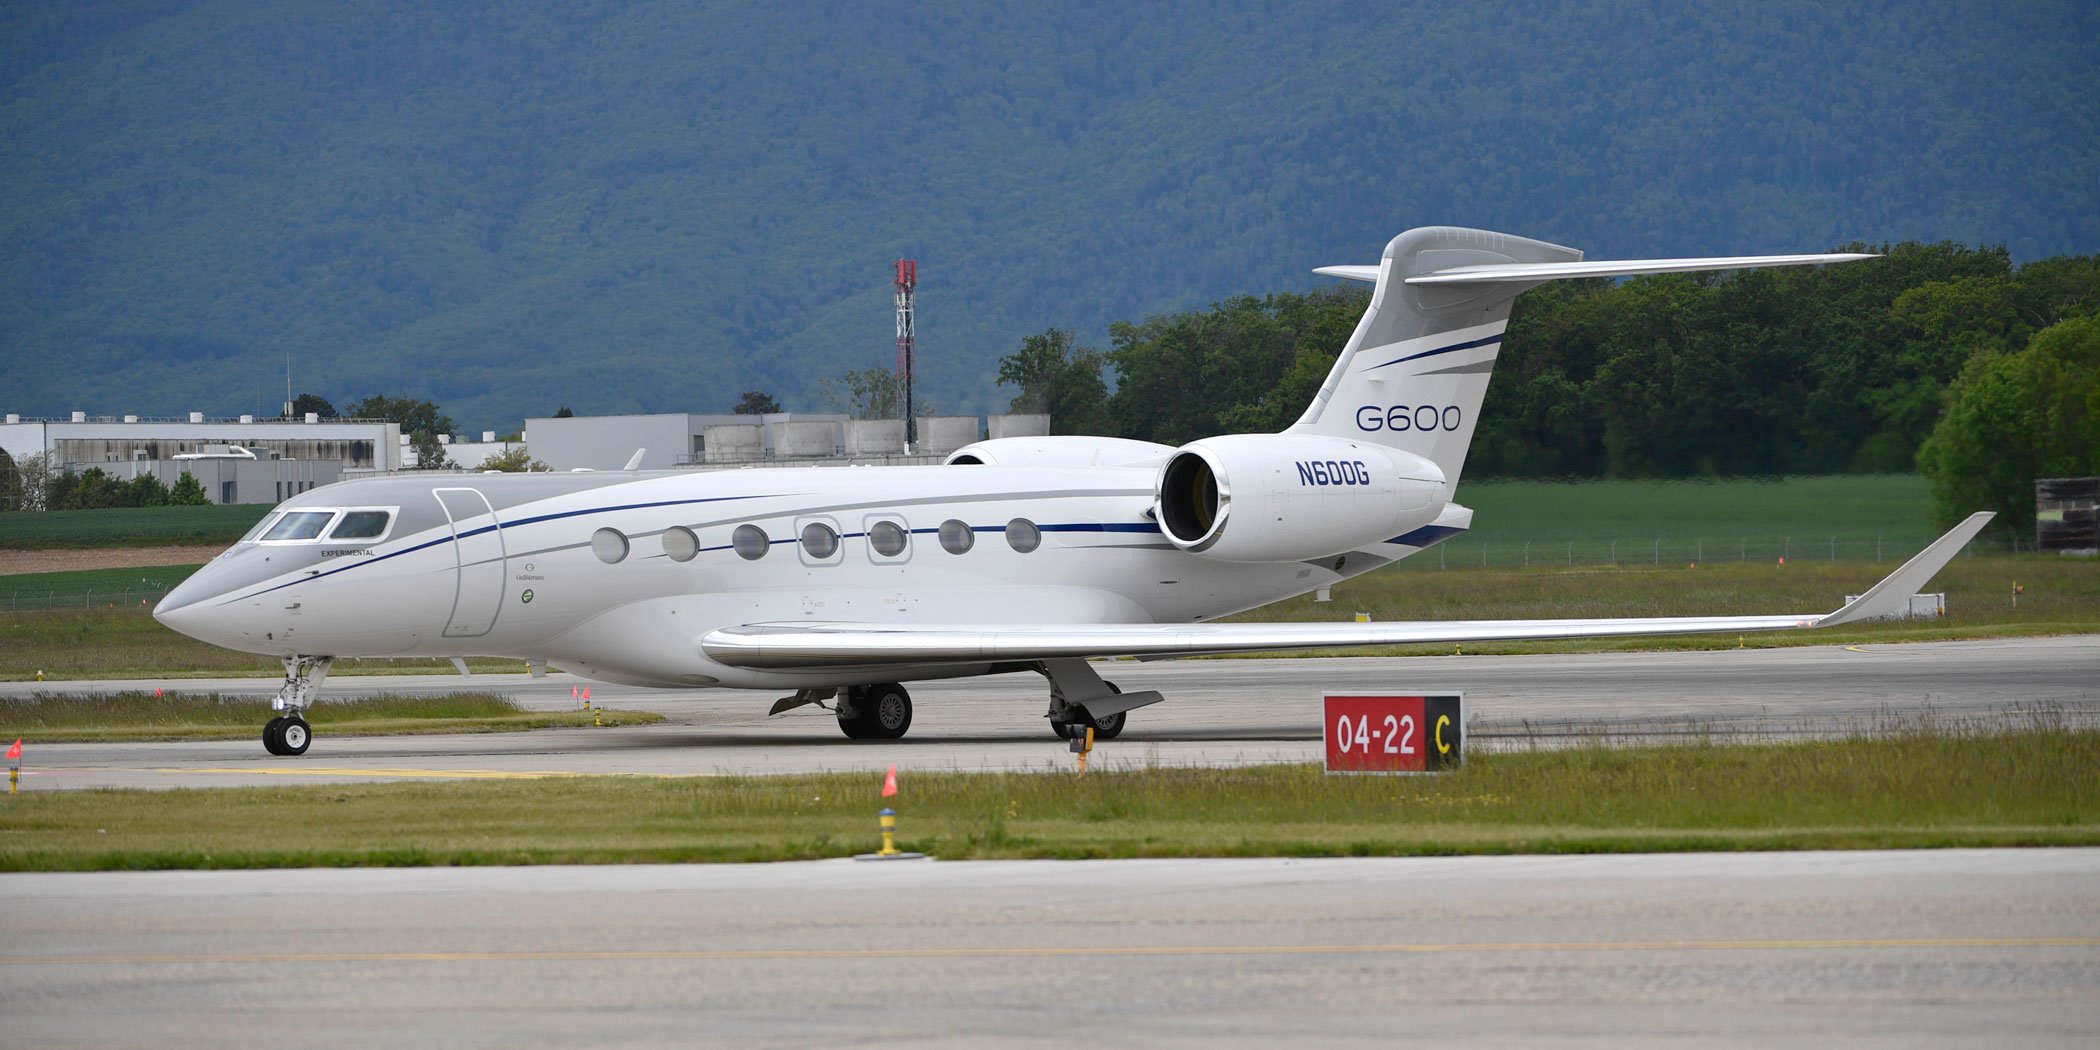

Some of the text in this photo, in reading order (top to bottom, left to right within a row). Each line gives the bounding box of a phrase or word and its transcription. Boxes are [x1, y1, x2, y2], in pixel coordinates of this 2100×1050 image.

[1356, 405, 1461, 432] G600
[1295, 460, 1370, 486] N600G
[321, 549, 375, 557] EXPERIMENTAL
[1337, 714, 1451, 754] 04-22 C
